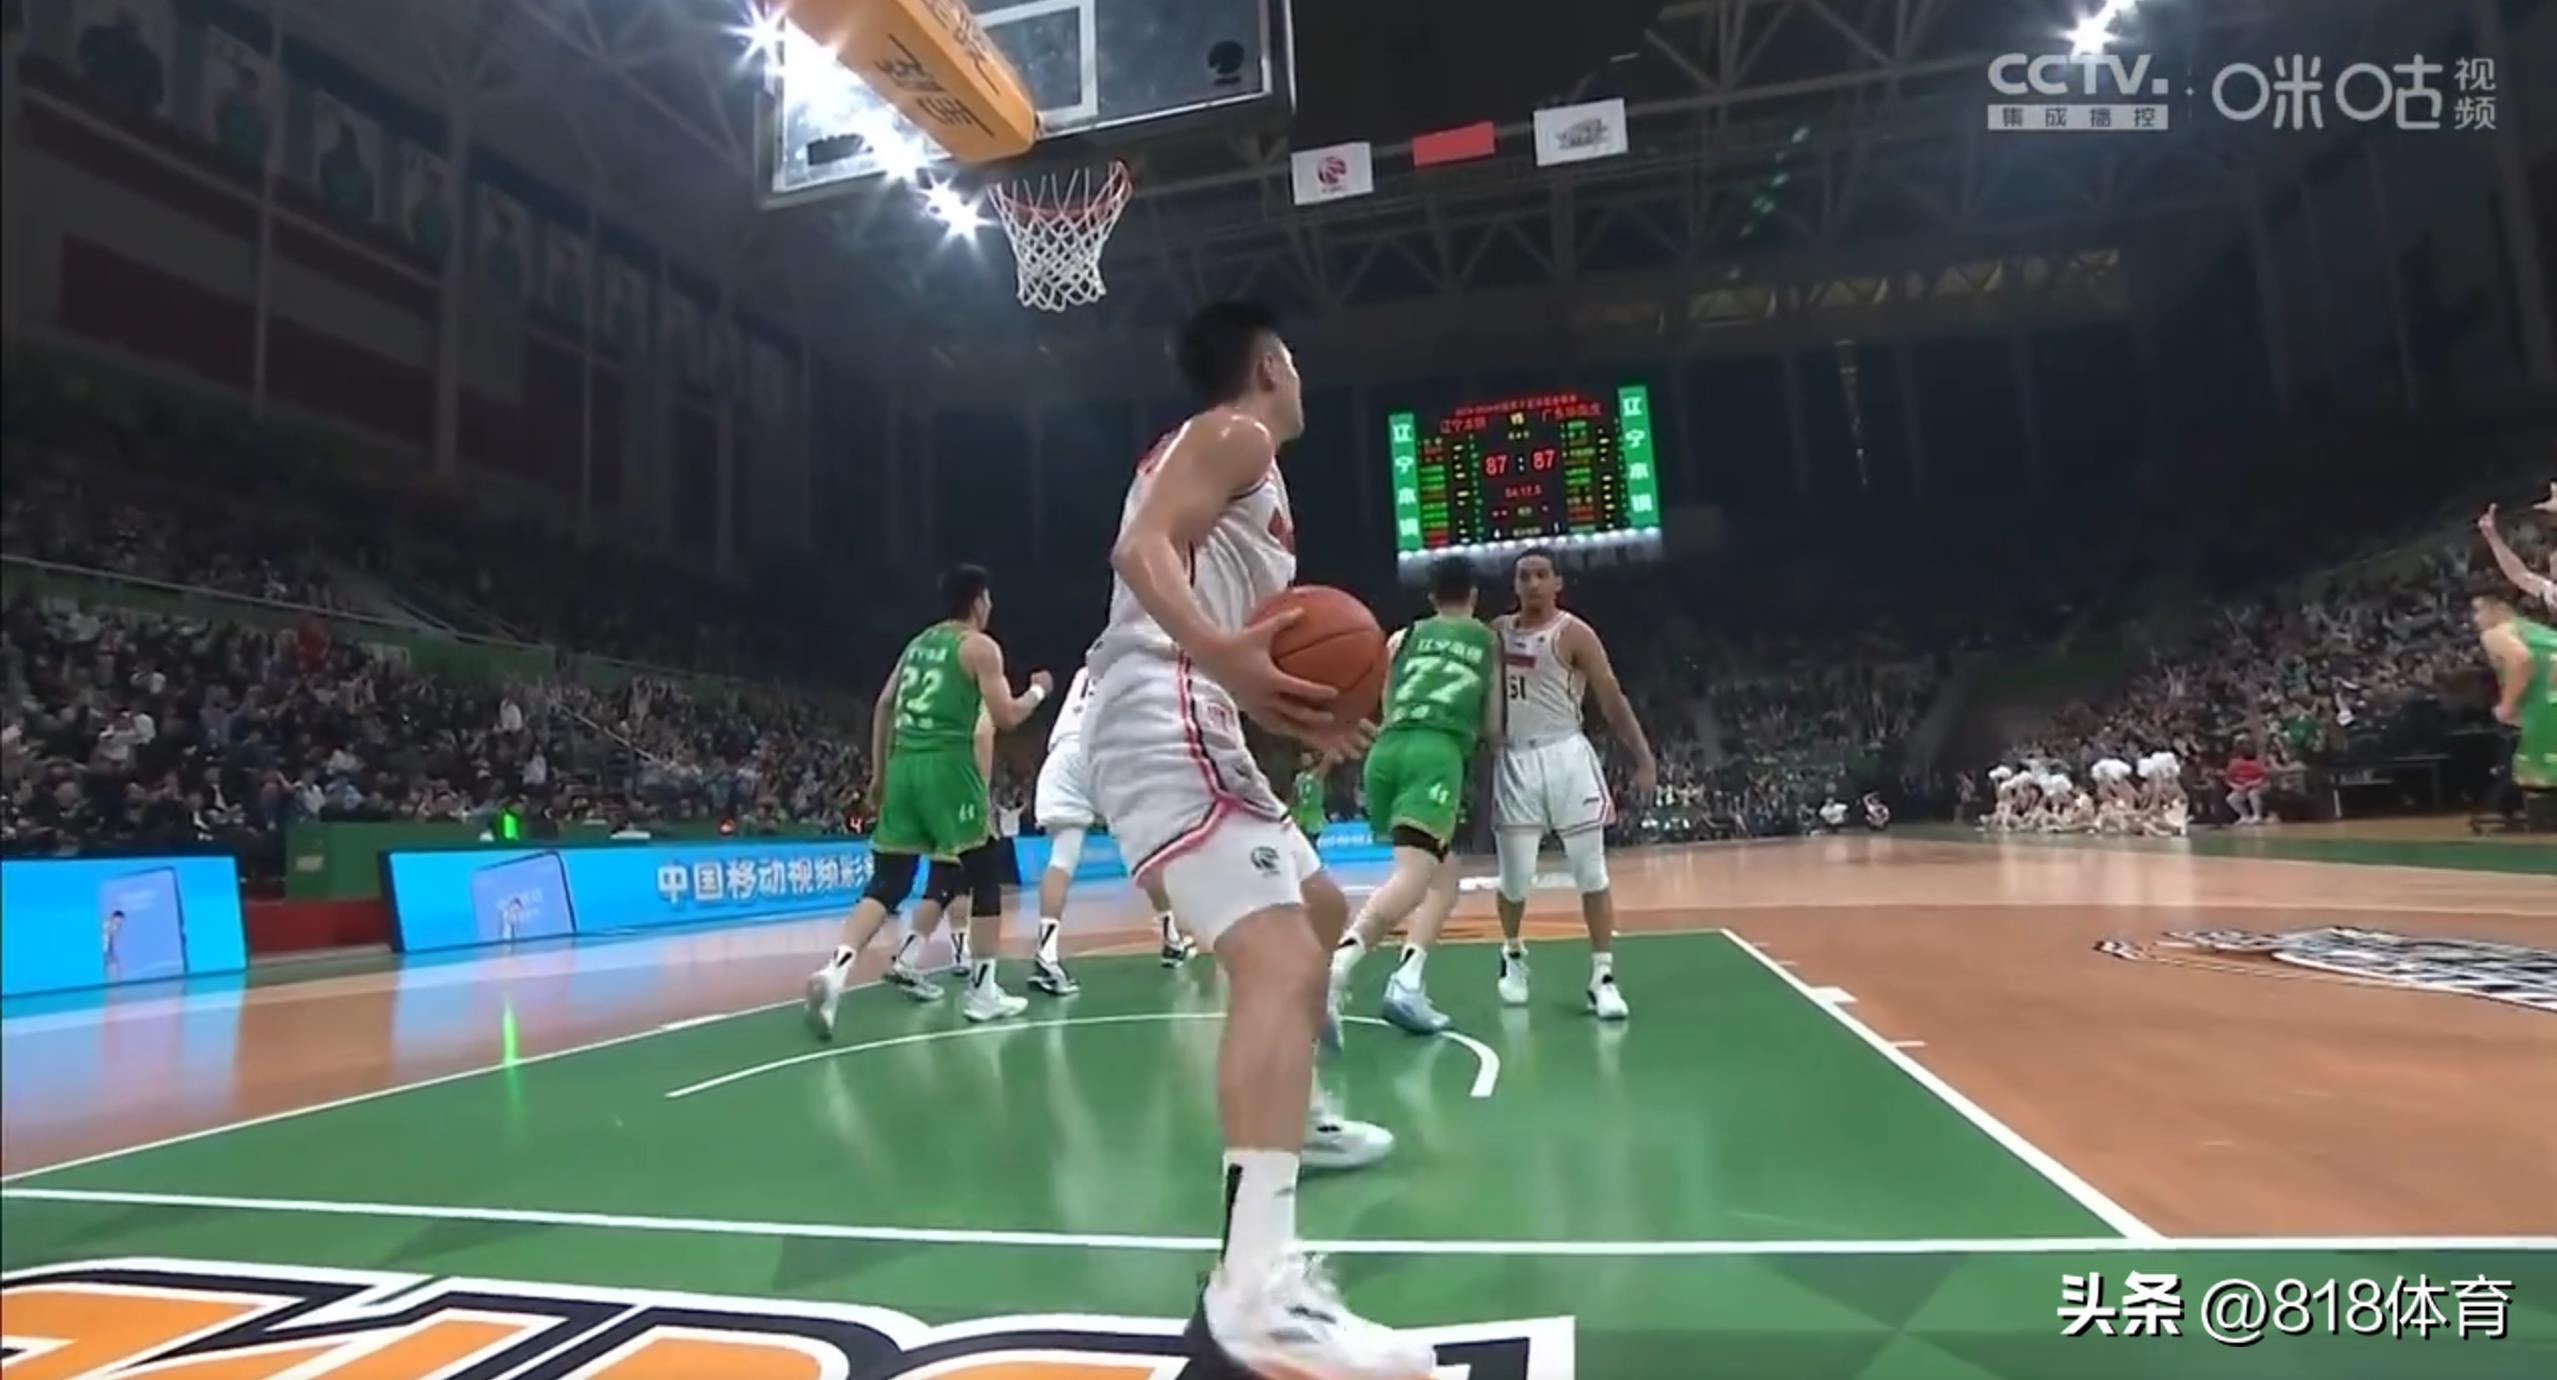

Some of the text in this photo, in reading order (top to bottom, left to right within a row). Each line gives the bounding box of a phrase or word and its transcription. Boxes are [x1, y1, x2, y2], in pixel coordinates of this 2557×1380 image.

[1485, 455, 1507, 476] 87
[1532, 449, 1556, 470] 87
[901, 666, 944, 713] 22
[1395, 655, 1480, 704] 77
